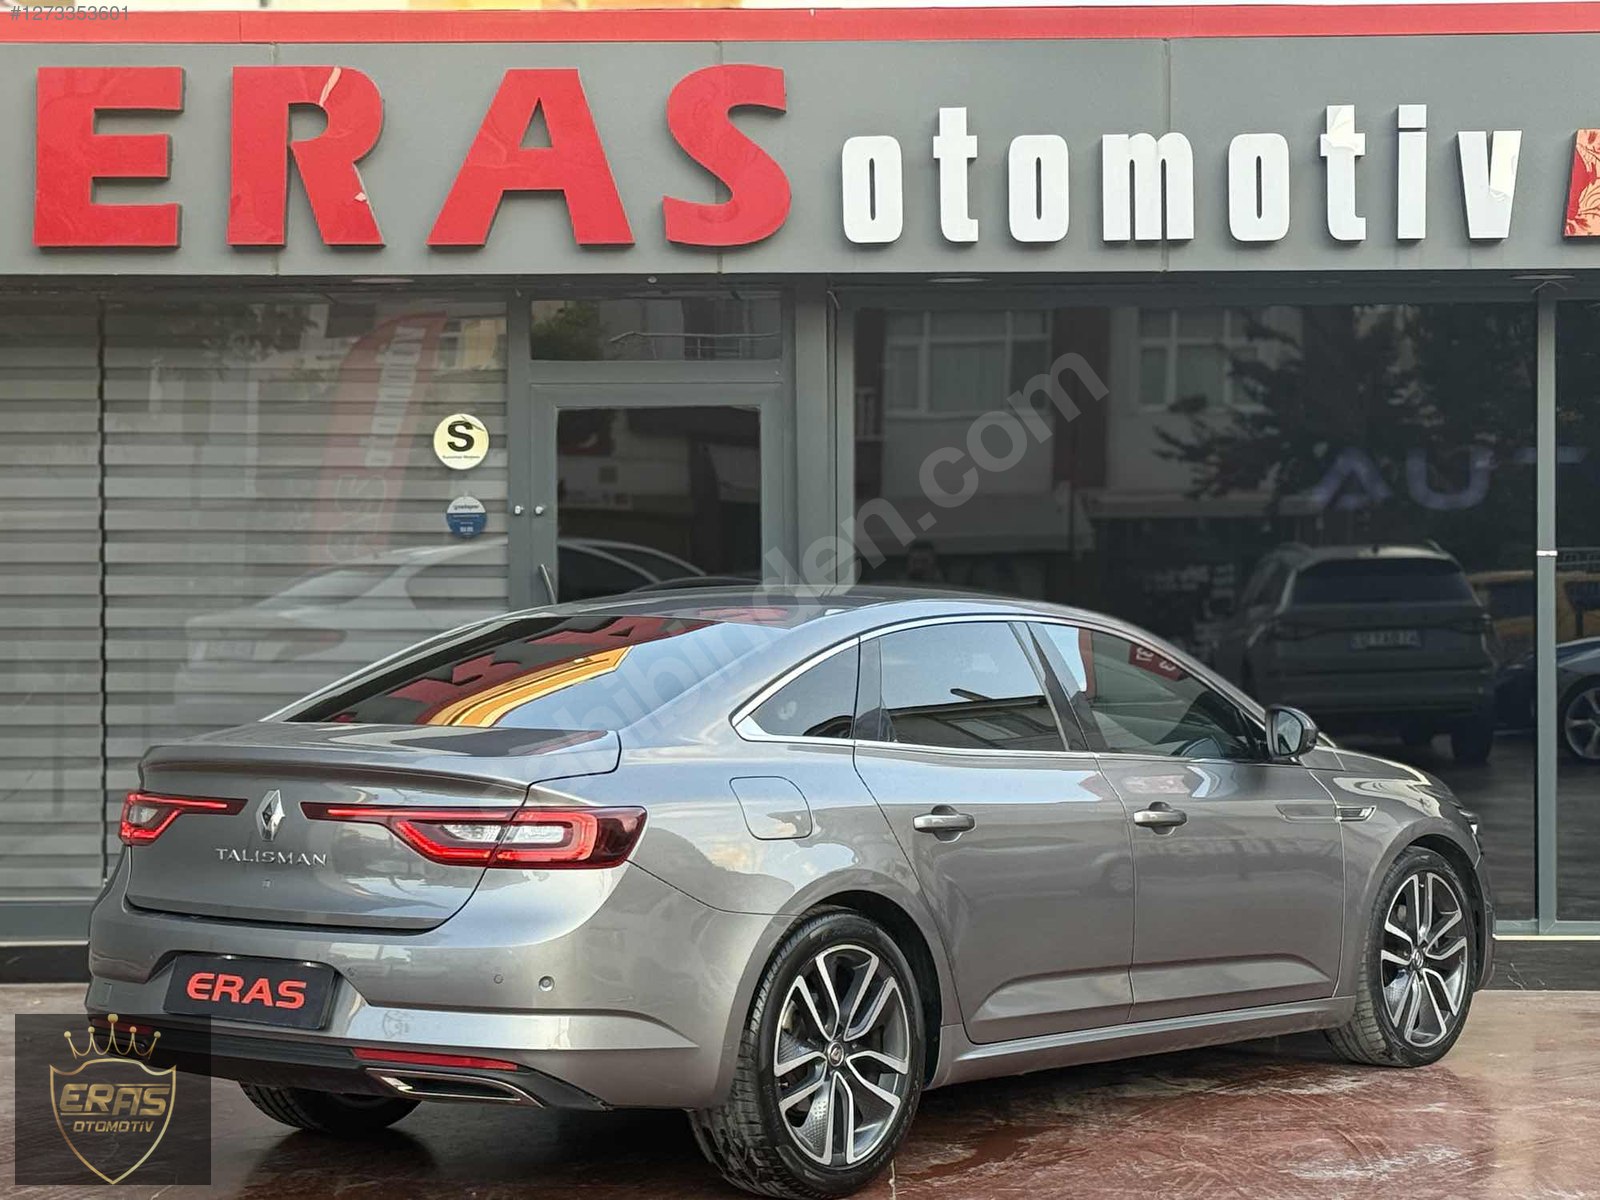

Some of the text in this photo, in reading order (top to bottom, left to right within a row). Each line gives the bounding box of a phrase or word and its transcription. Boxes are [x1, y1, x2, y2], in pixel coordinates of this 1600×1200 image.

[33, 64, 1522, 249] ERAS otomotiv
[215, 848, 328, 867] TALISMAN
[186, 972, 307, 1010] ERAS
